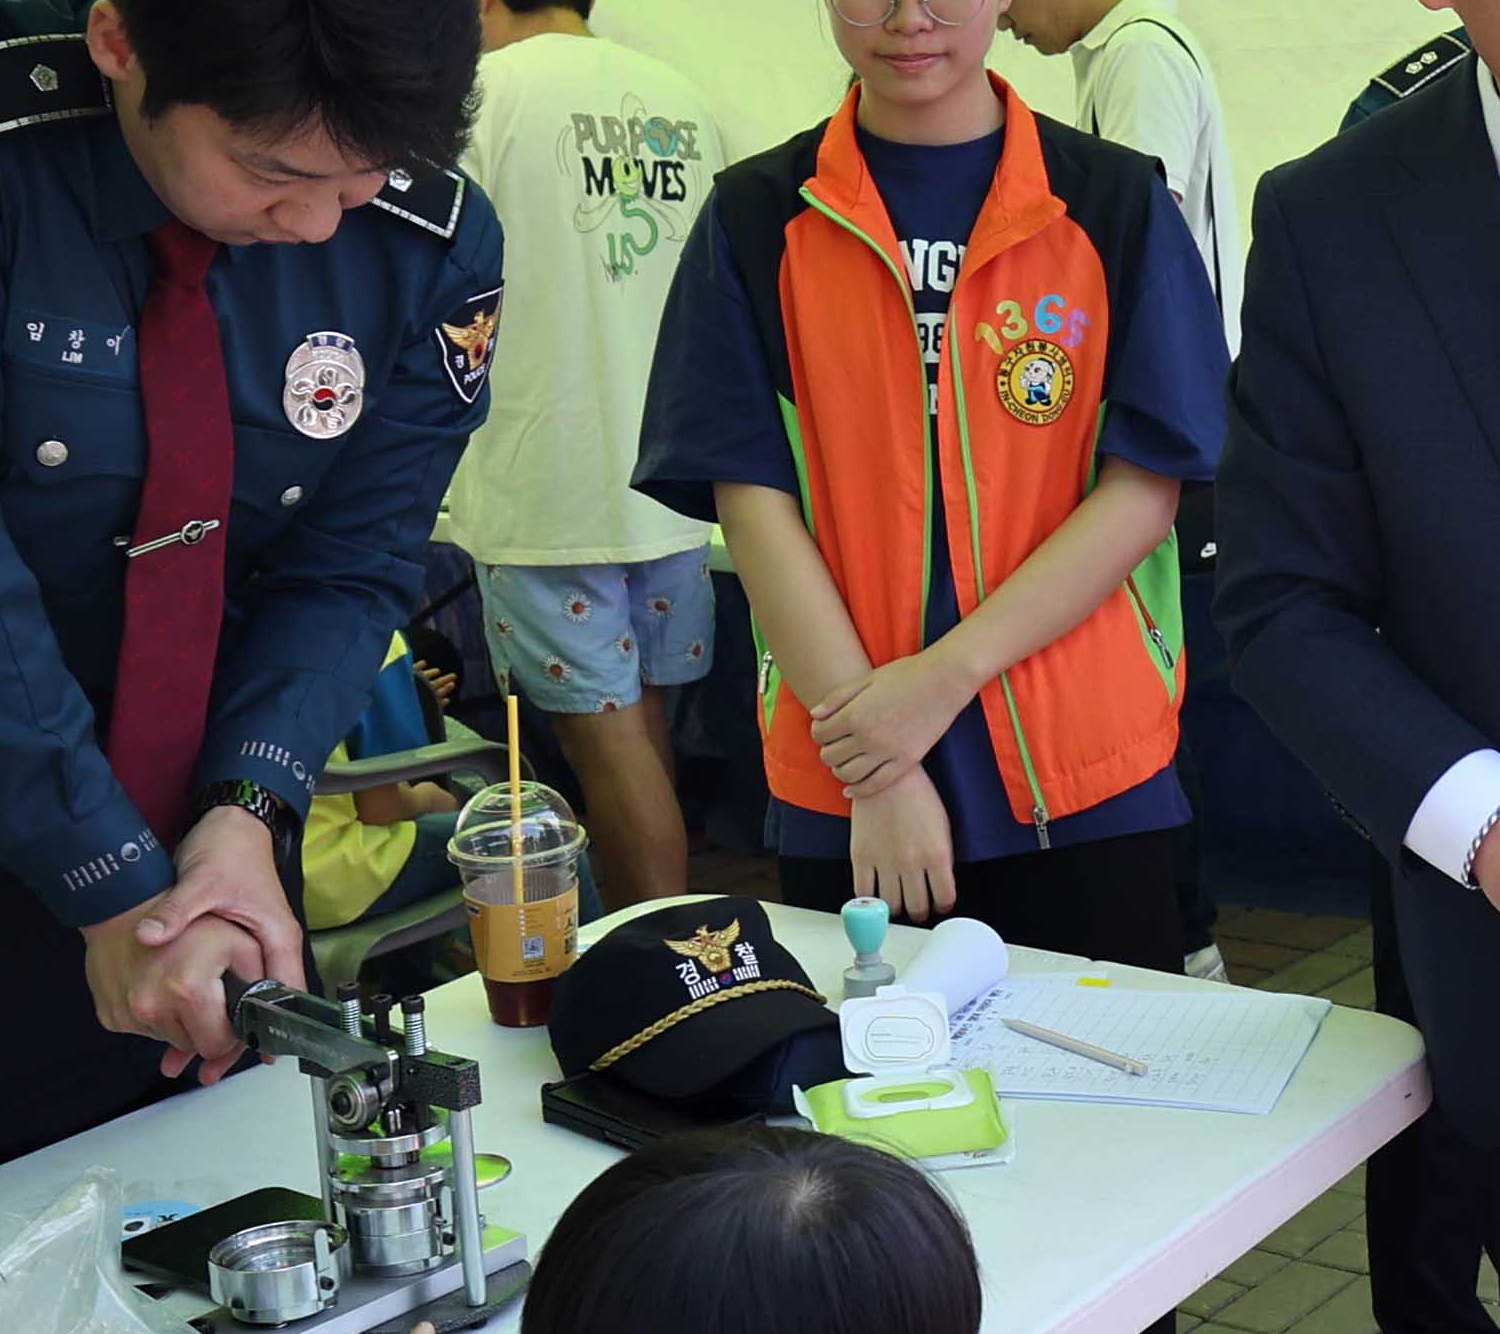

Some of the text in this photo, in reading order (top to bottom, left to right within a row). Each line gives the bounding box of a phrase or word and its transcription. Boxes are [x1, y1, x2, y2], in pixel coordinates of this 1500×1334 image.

[974, 294, 1091, 355] 1365
[675, 941, 759, 986] 경 찰
